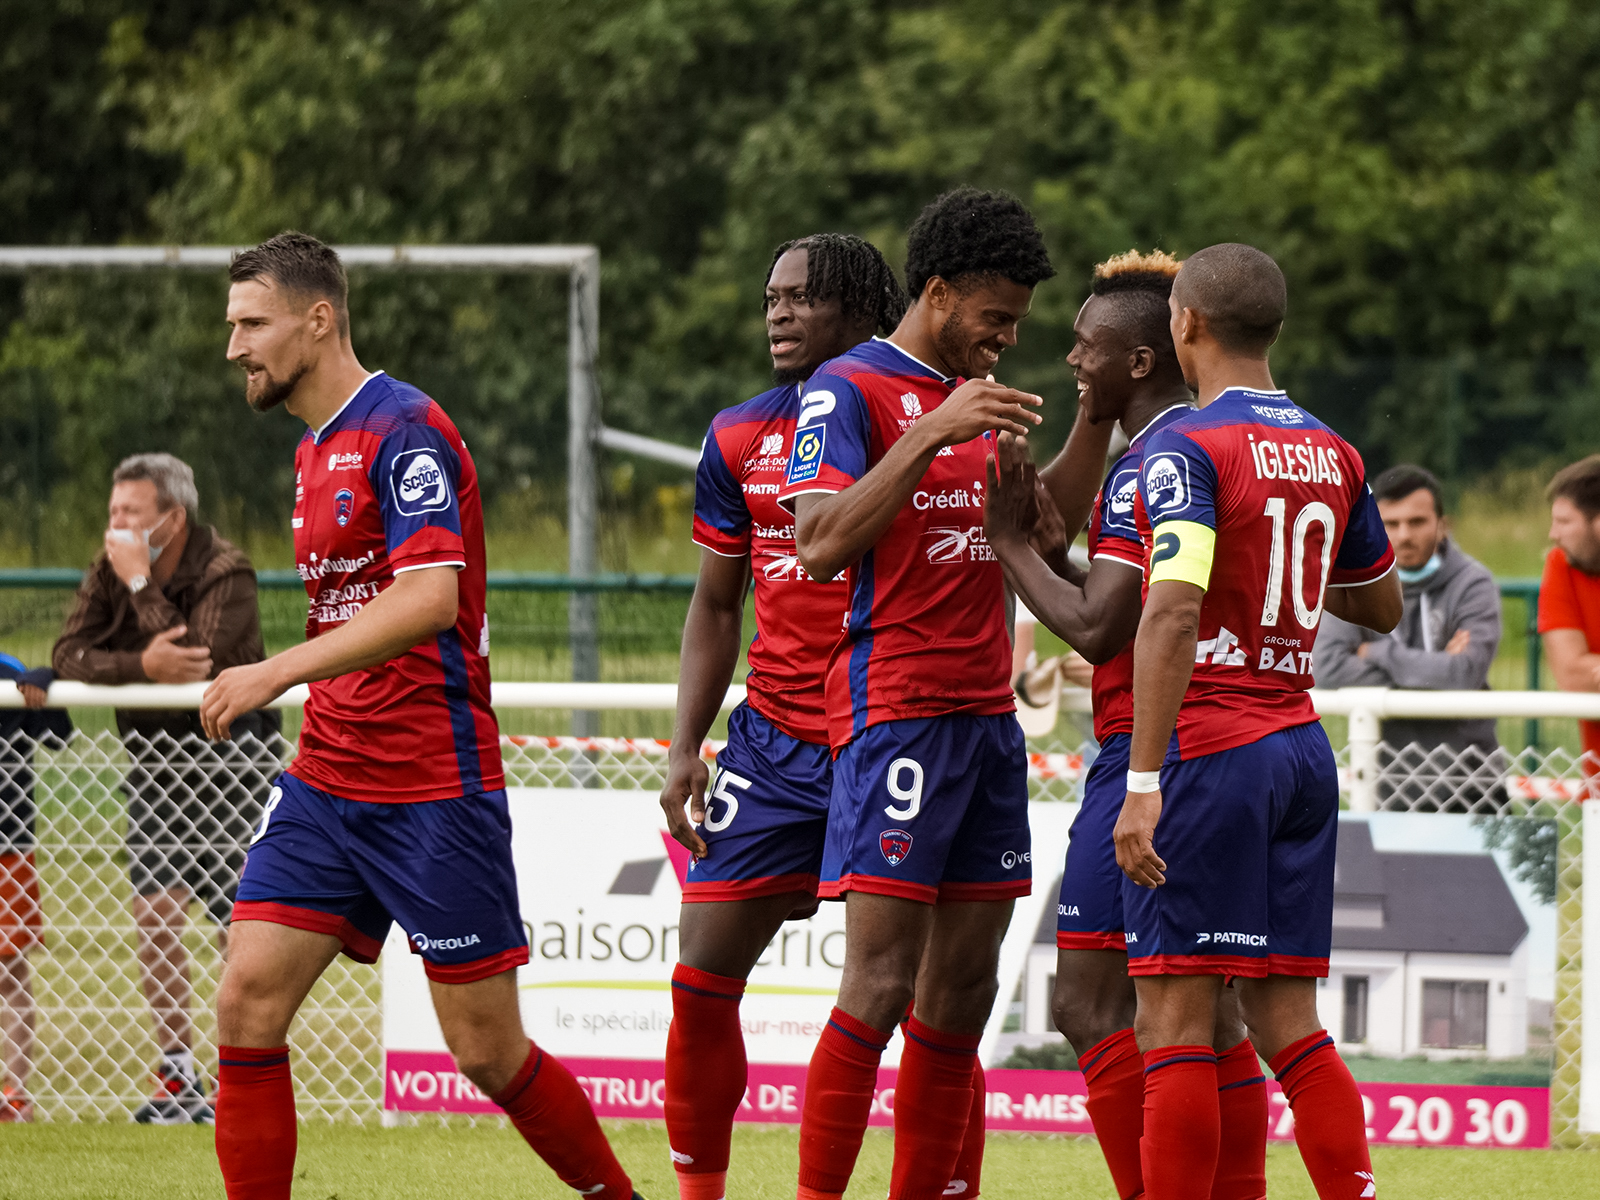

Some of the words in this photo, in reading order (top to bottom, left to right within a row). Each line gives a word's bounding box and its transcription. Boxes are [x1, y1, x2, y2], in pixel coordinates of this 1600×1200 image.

[794, 462, 812, 472] LIGUE
[402, 469, 440, 493] SCOOP
[748, 483, 780, 495] PATRI
[912, 489, 970, 511] Crédit
[1260, 497, 1336, 630] 10
[1263, 635, 1301, 648] GROUPE
[884, 757, 924, 821] 9
[429, 933, 482, 950] VEOLIA
[1213, 932, 1268, 947] PATRICK
[555, 1006, 576, 1030] le
[758, 1084, 798, 1112] DE
[1387, 1094, 1453, 1142] 20
[1464, 1097, 1528, 1144] 30
